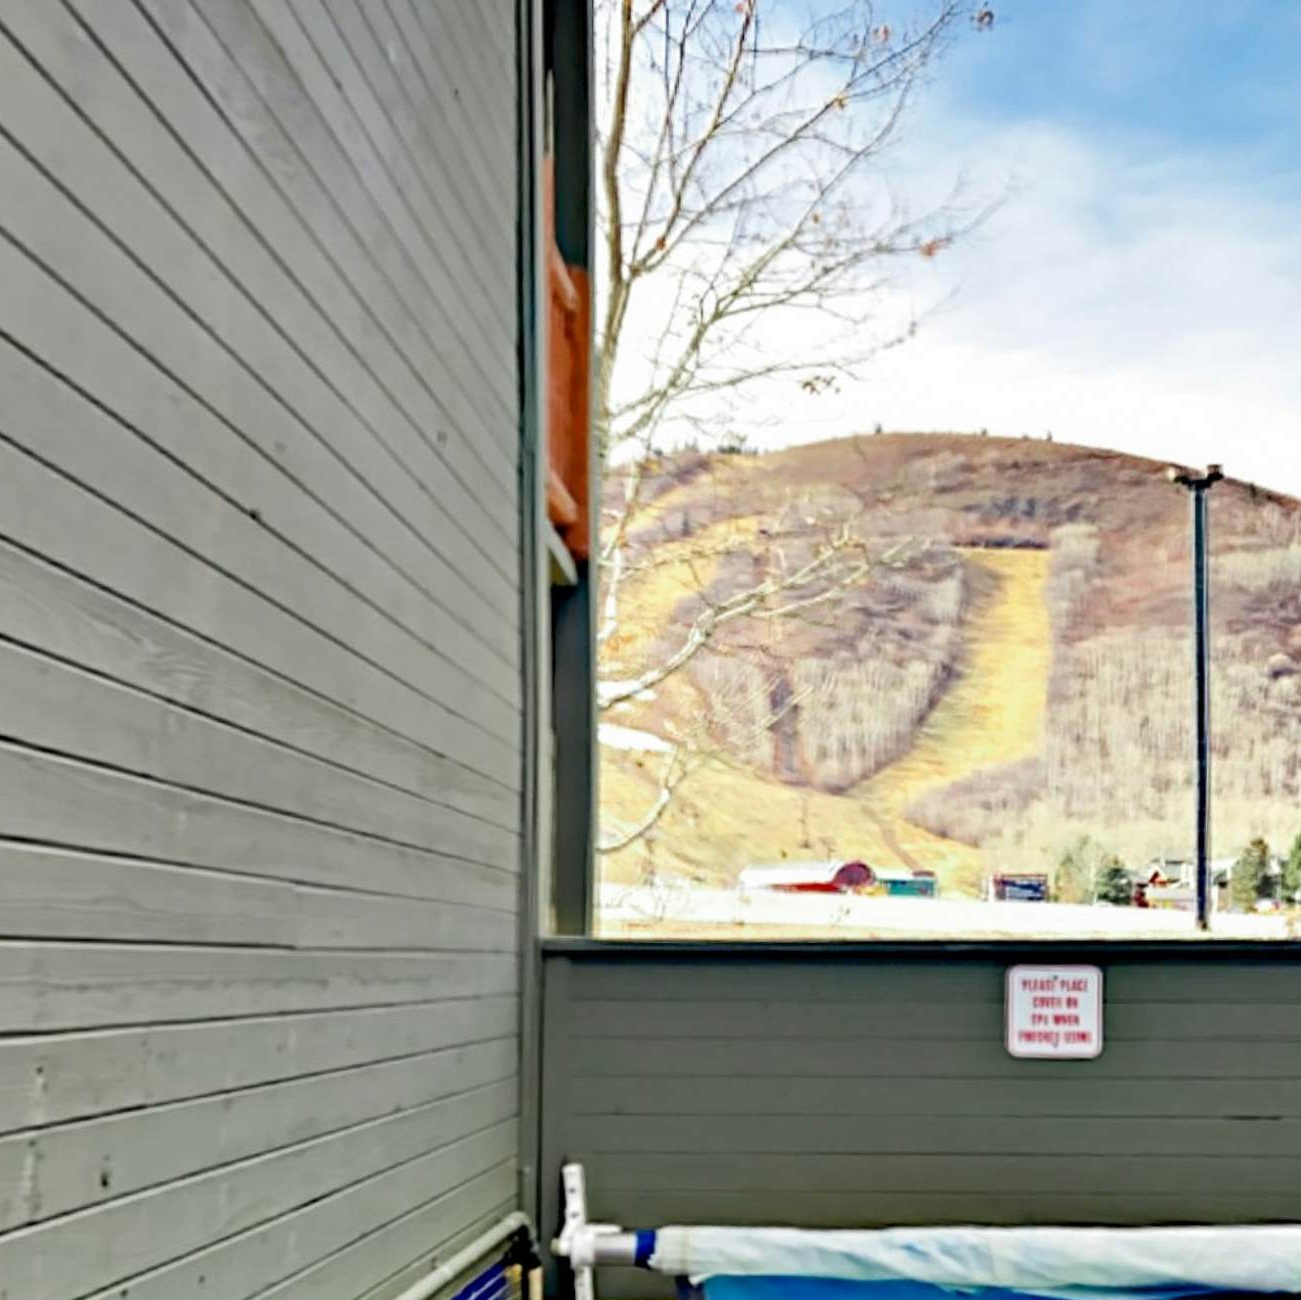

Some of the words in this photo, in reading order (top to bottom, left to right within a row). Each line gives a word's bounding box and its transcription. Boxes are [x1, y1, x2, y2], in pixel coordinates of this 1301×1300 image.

[1021, 979, 1055, 992] PLEASE
[1061, 979, 1088, 992] PLACE
[1052, 1013, 1080, 1025] WHEN
